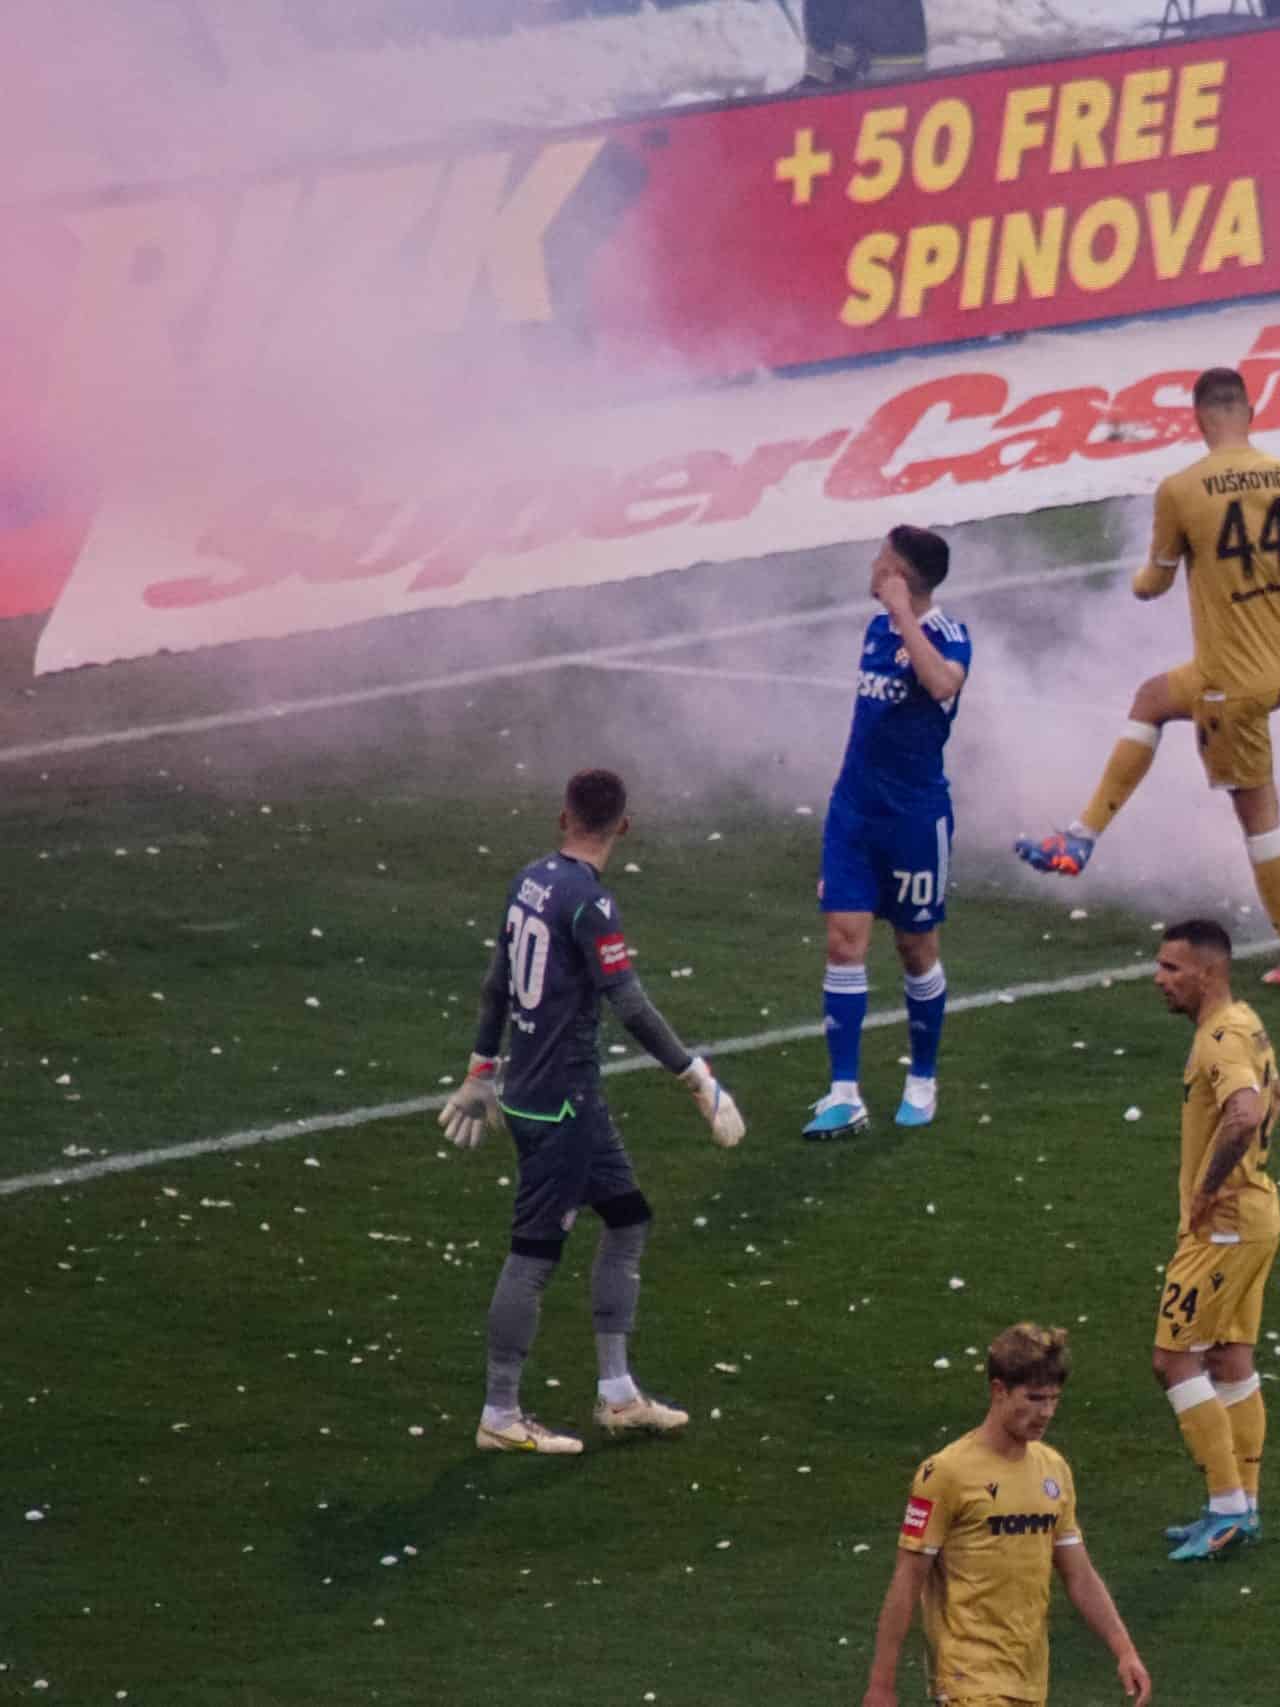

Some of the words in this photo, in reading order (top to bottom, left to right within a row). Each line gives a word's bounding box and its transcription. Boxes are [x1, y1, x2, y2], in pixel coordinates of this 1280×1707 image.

[996, 61, 1227, 182] FREE
[839, 178, 1264, 327] SPINOVA
[893, 870, 932, 906] 70
[1162, 1282, 1198, 1323] 24
[986, 1513, 1058, 1536] TOMMY
